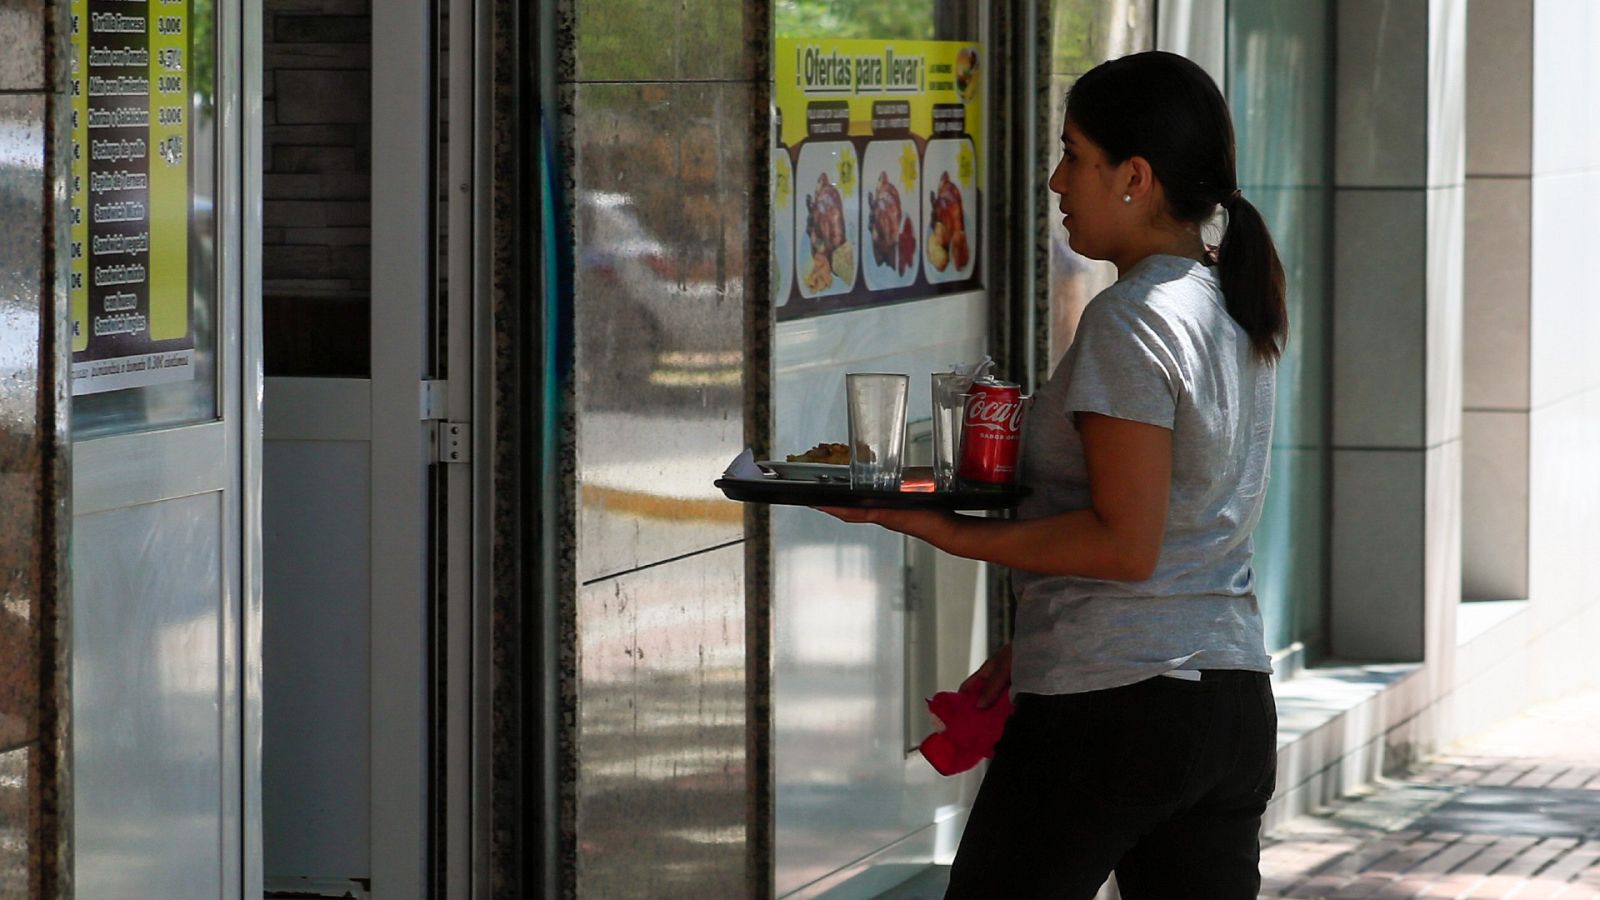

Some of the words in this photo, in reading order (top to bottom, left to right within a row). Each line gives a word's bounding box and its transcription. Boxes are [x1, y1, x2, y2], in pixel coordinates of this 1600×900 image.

[92, 13, 115, 32] Tortilla
[115, 13, 145, 32] Francesa
[159, 17, 181, 34] 3,00€
[112, 50, 125, 66] con
[124, 47, 148, 66] Tomate
[805, 47, 851, 86] Ofertas
[855, 57, 882, 94] para
[886, 48, 918, 86] llevar
[106, 80, 118, 96] con
[118, 76, 149, 95] Pimientos
[159, 75, 181, 93] 3,00€
[88, 108, 110, 128] Chorizo
[159, 106, 182, 125] 3,00€
[92, 140, 120, 162] Pechuga
[120, 139, 129, 159] de
[129, 138, 146, 162] pollo
[91, 171, 113, 195] Pepito
[112, 171, 122, 190] de
[121, 171, 147, 190] Ternera
[94, 202, 126, 223] Sandwich
[93, 234, 125, 255] Sandwich
[125, 232, 148, 256] vegetal
[95, 265, 127, 286] Sandwich
[104, 295, 118, 311] con
[117, 291, 138, 309] huevo
[95, 315, 127, 336] Sandwich
